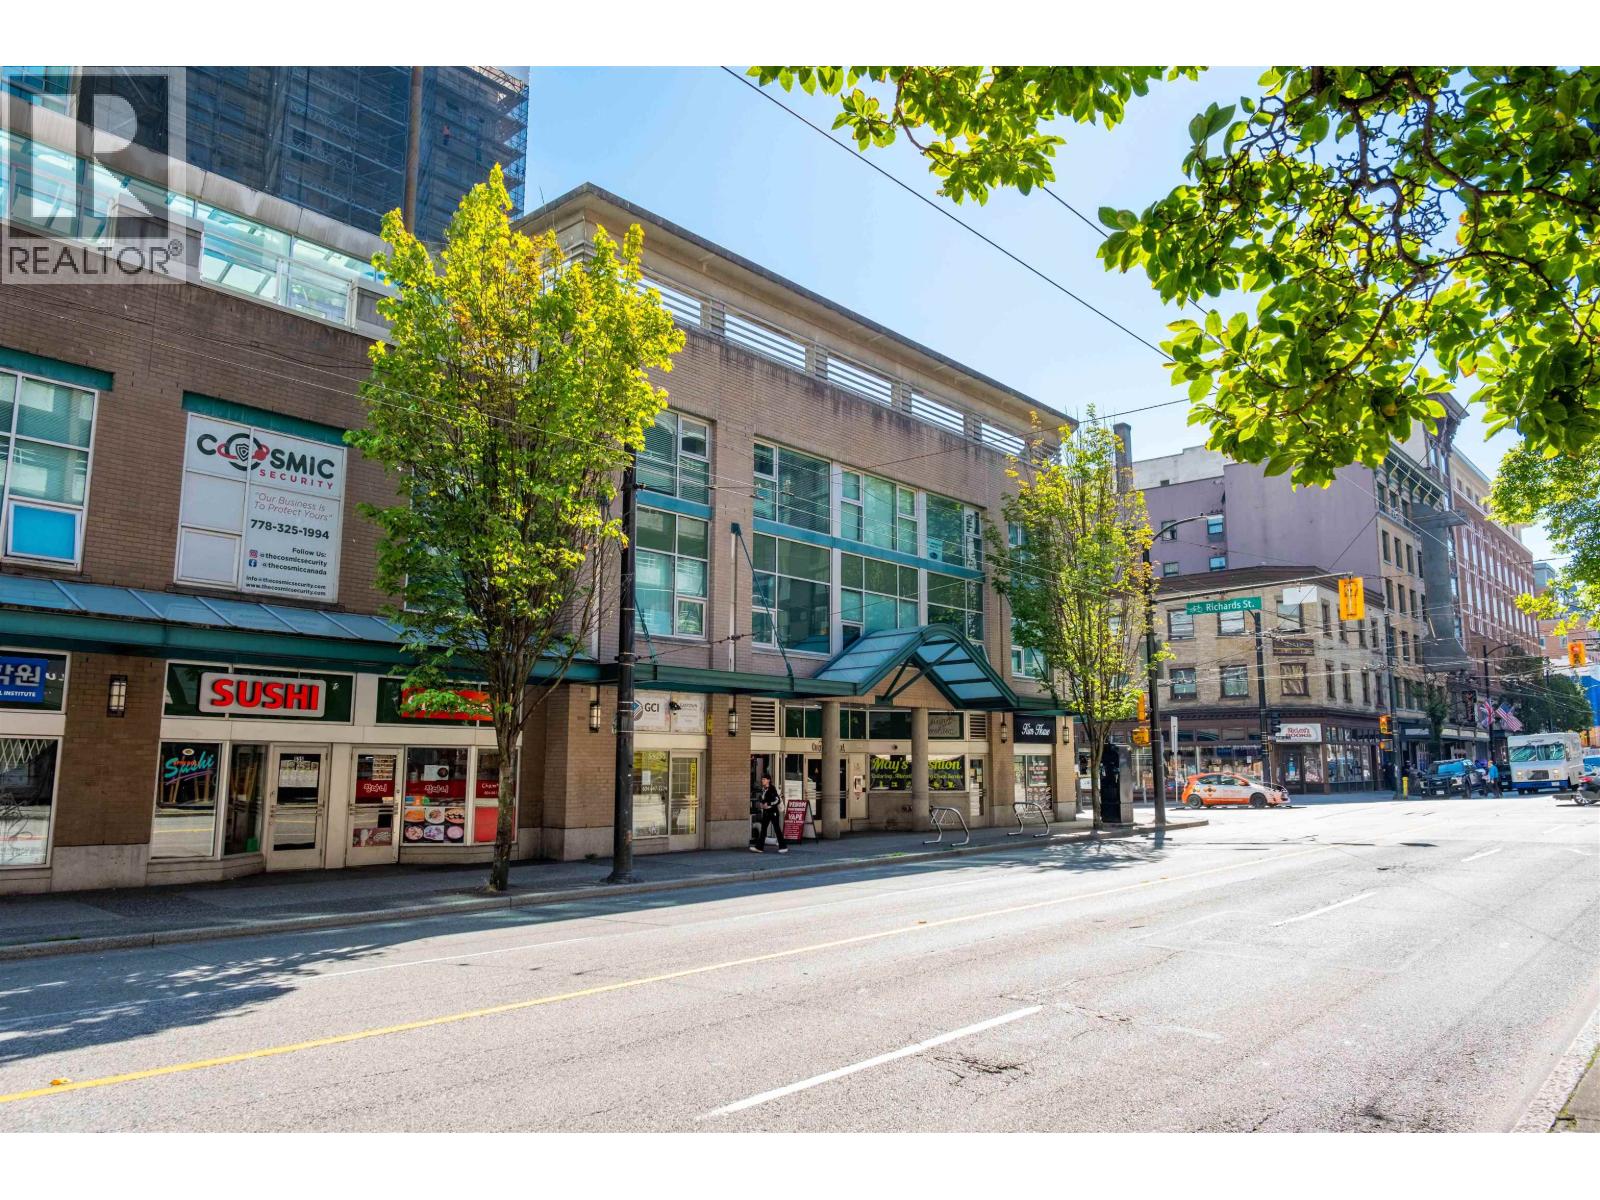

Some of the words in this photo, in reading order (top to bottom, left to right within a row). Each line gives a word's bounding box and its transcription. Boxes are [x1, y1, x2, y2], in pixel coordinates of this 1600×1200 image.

[197, 433, 335, 479] COSMIC
[259, 469, 334, 490] SECURITY
[254, 501, 265, 510] To
[268, 503, 301, 517] Protect
[278, 496, 316, 511] Business
[250, 519, 330, 540] 778-325-1994
[292, 547, 314, 556] Follow
[1205, 601, 1241, 612] Richards
[1243, 599, 1255, 609] St.
[4, 690, 36, 698] INSTITUTE
[211, 678, 320, 711] SUSHI
[644, 702, 660, 713] GCI
[164, 751, 214, 778] Sushi
[872, 757, 908, 773] May's
[788, 813, 803, 821] VAPE
